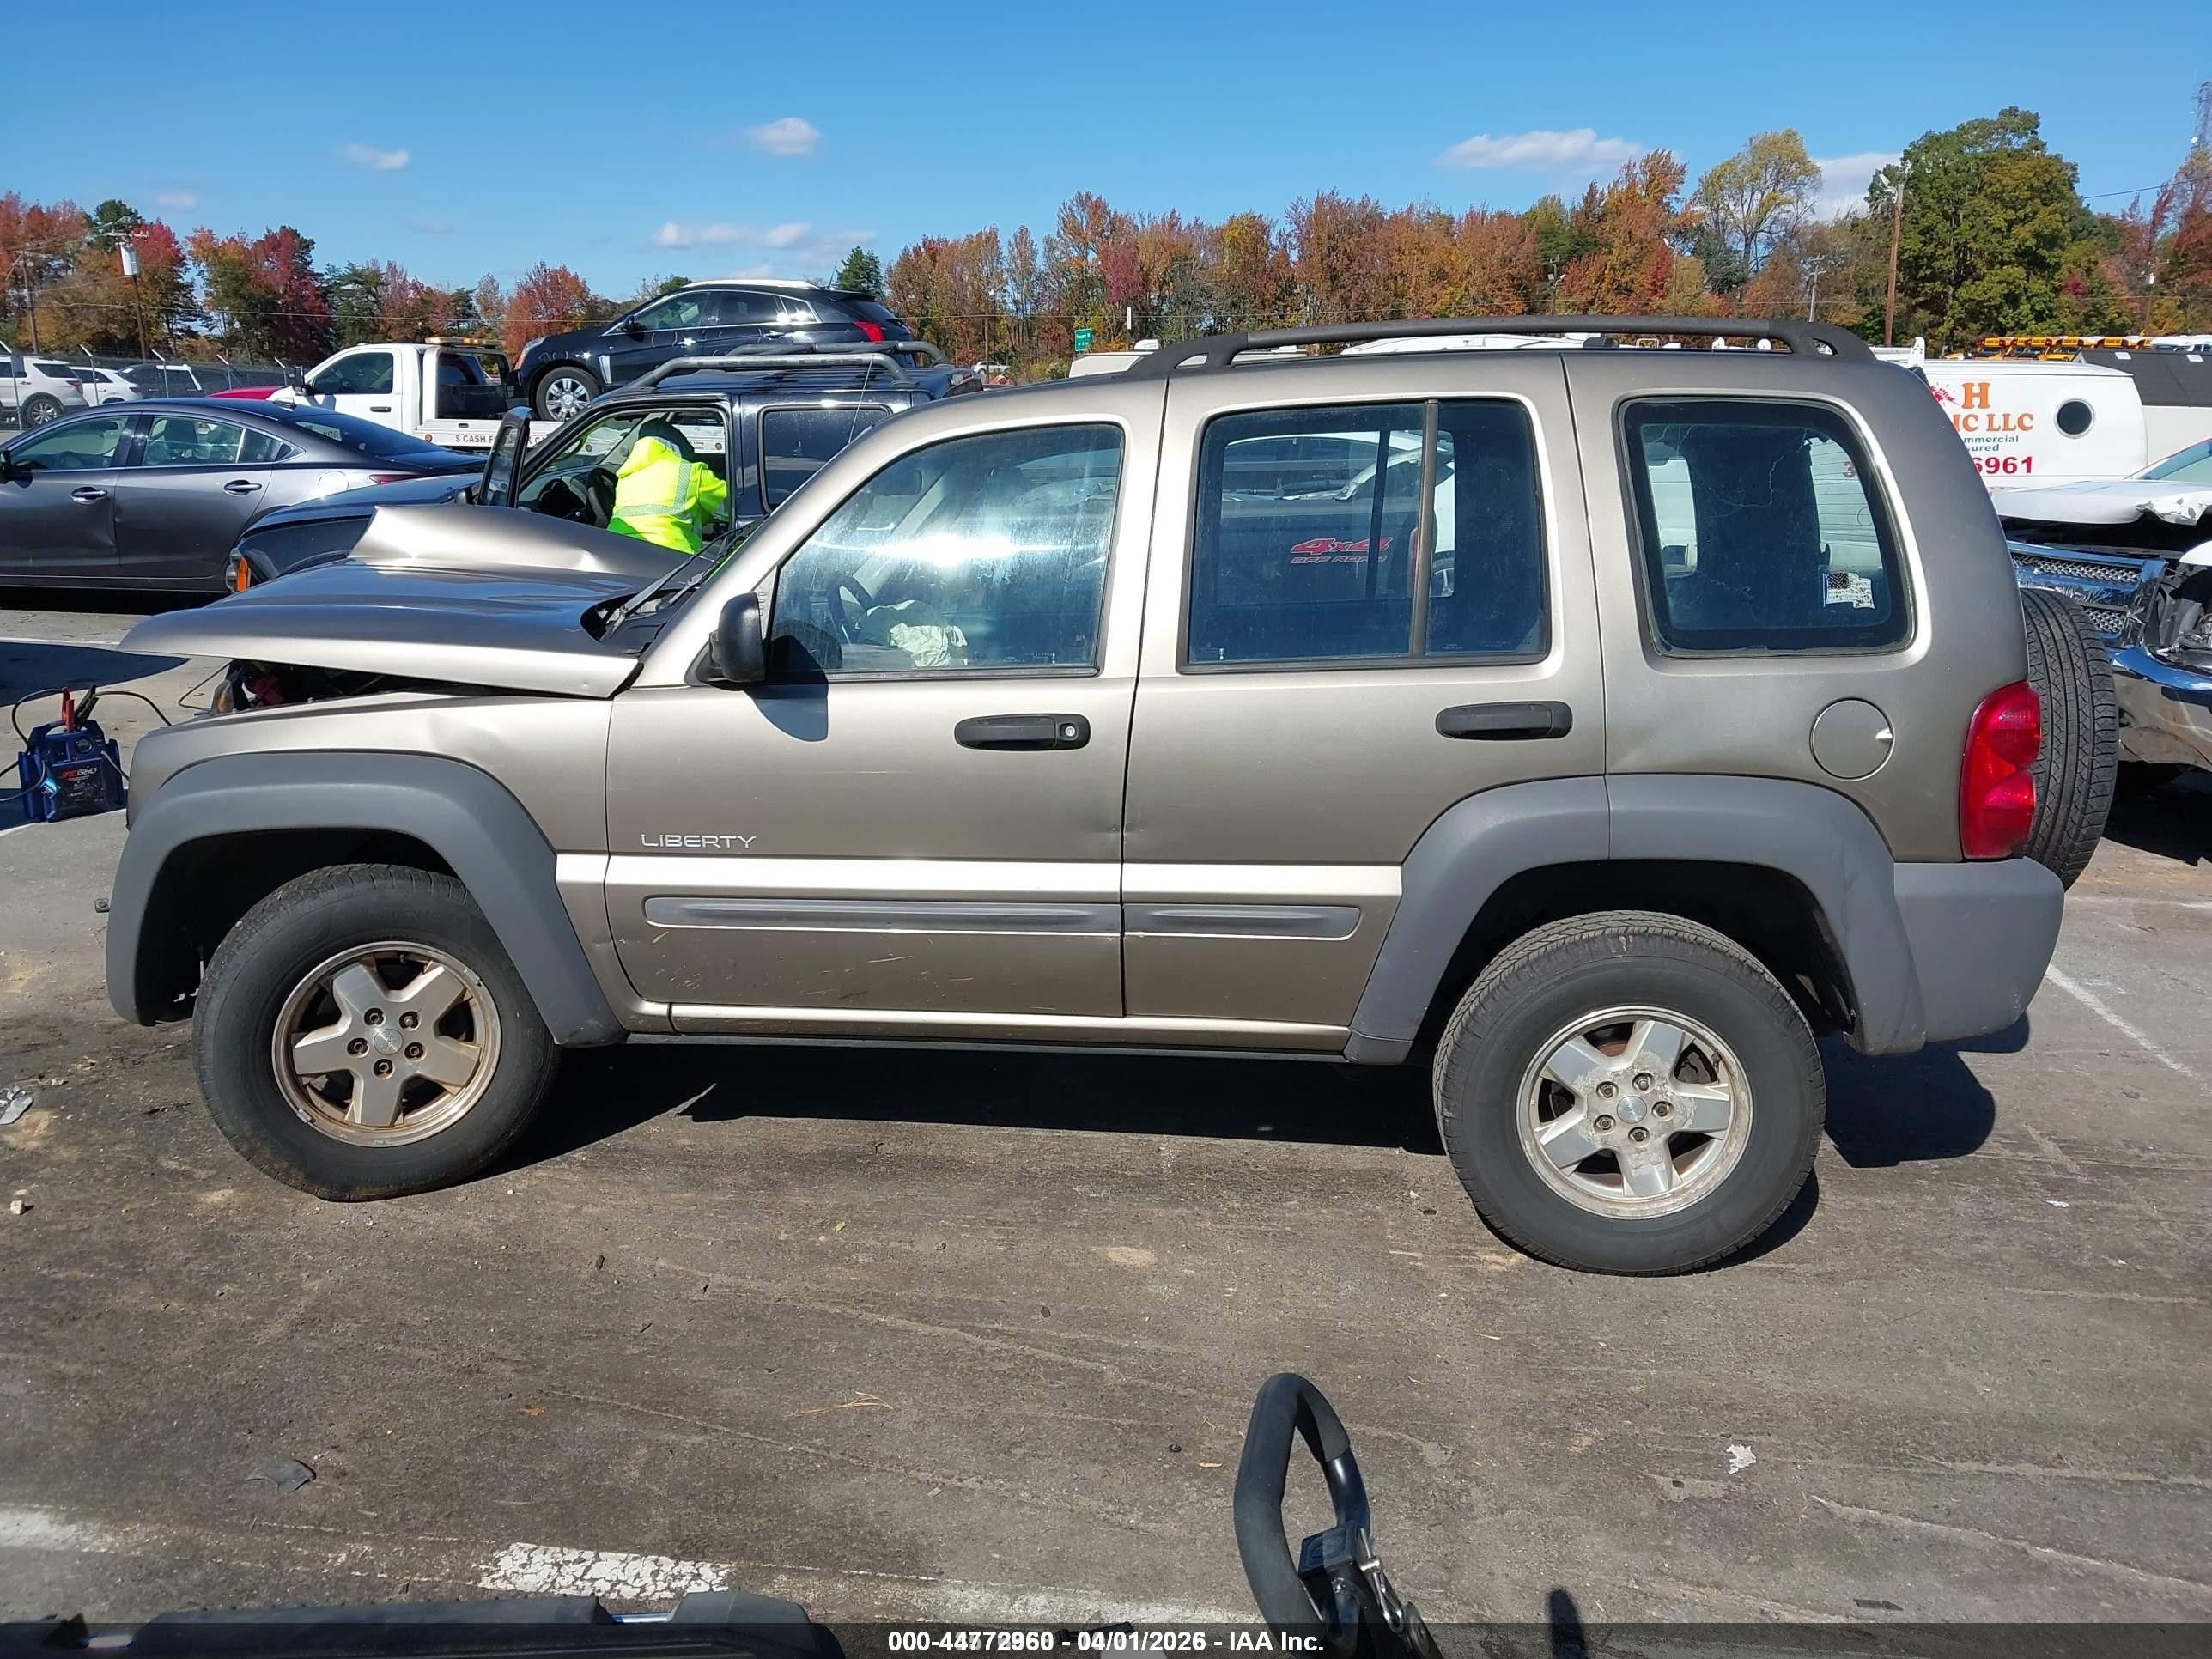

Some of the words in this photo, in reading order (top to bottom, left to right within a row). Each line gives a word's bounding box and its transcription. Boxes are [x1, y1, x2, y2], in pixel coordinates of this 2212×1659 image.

[1961, 382, 1990, 409] H
[1986, 413, 2034, 431] LLC
[463, 434, 486, 443] CASH
[641, 833, 757, 848] LIBERTY
